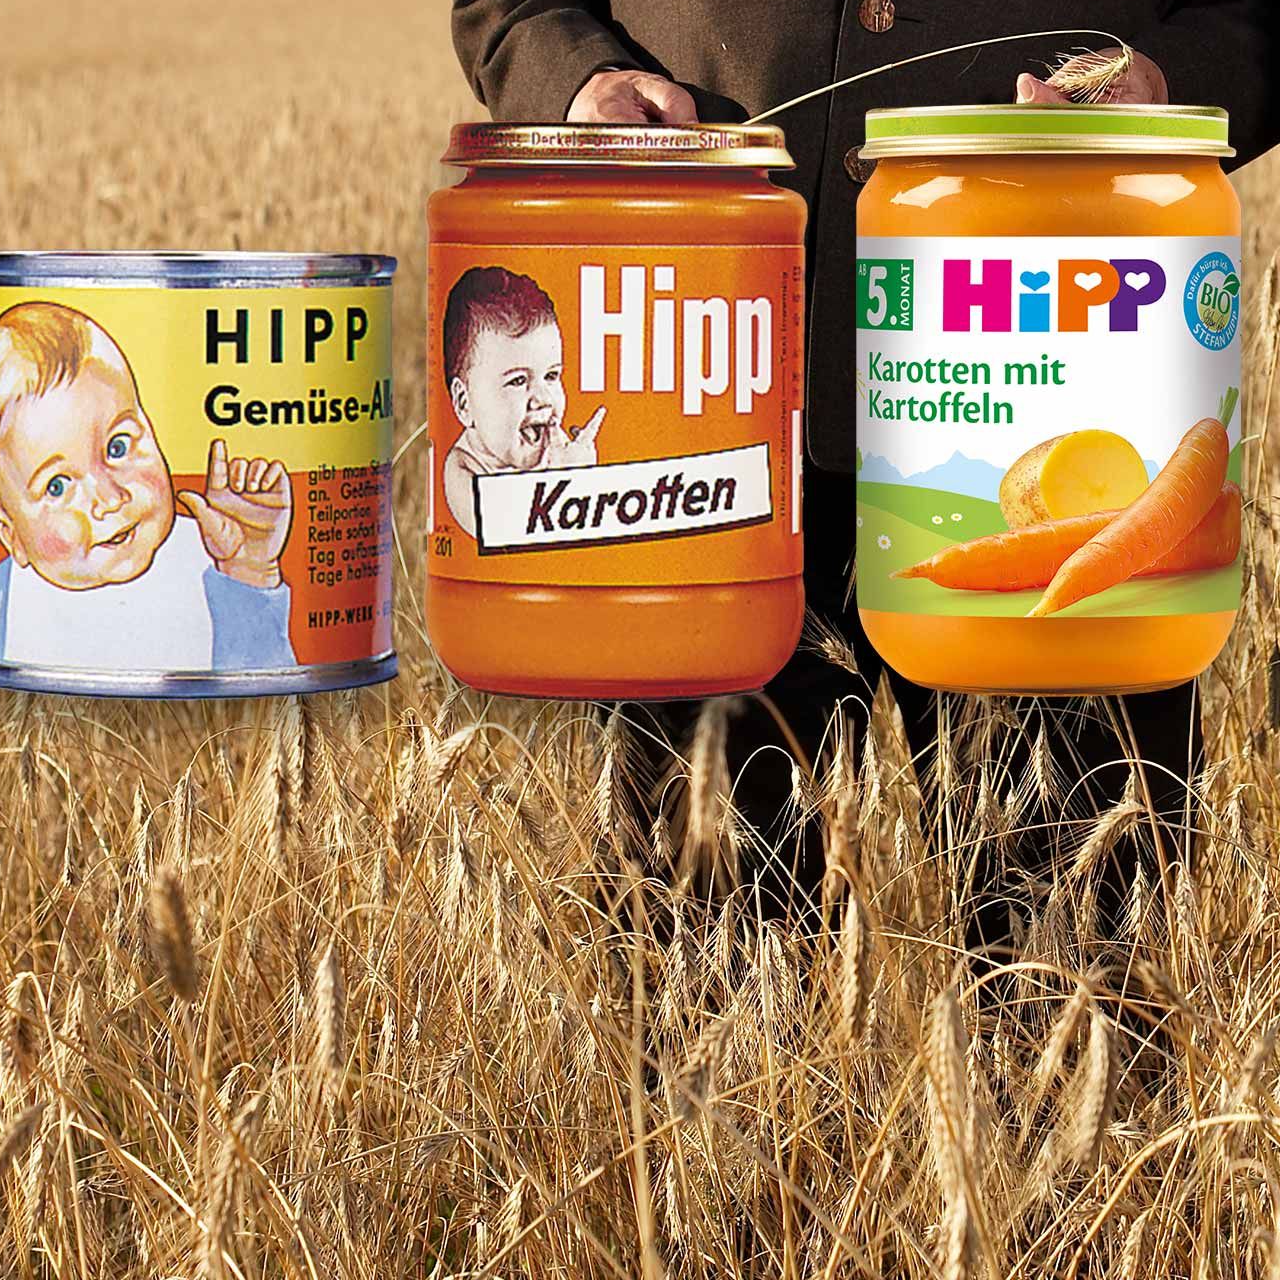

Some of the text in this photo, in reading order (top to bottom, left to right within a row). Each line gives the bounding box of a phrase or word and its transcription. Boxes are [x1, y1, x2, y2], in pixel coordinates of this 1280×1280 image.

[621, 132, 691, 148] mehreren
[858, 263, 867, 276] AB
[1187, 271, 1201, 300] Dafür
[1200, 259, 1219, 273] bürge
[866, 266, 897, 327] 5.
[900, 263, 911, 326] MONAT
[942, 259, 1167, 332] HiPP
[1200, 282, 1231, 314] BIO
[205, 306, 368, 364] HIPP
[579, 265, 773, 415] Hipp
[1192, 323, 1226, 348] STEFAN
[1226, 311, 1238, 341] HIPP
[868, 351, 1066, 385] Karotten mit
[868, 389, 1013, 424] Kartoffeln
[308, 489, 331, 502] an.
[526, 473, 736, 534] Karotten
[308, 525, 342, 544] Reste
[434, 536, 452, 557] 201
[307, 546, 336, 567] Tag
[307, 566, 342, 587] Tage
